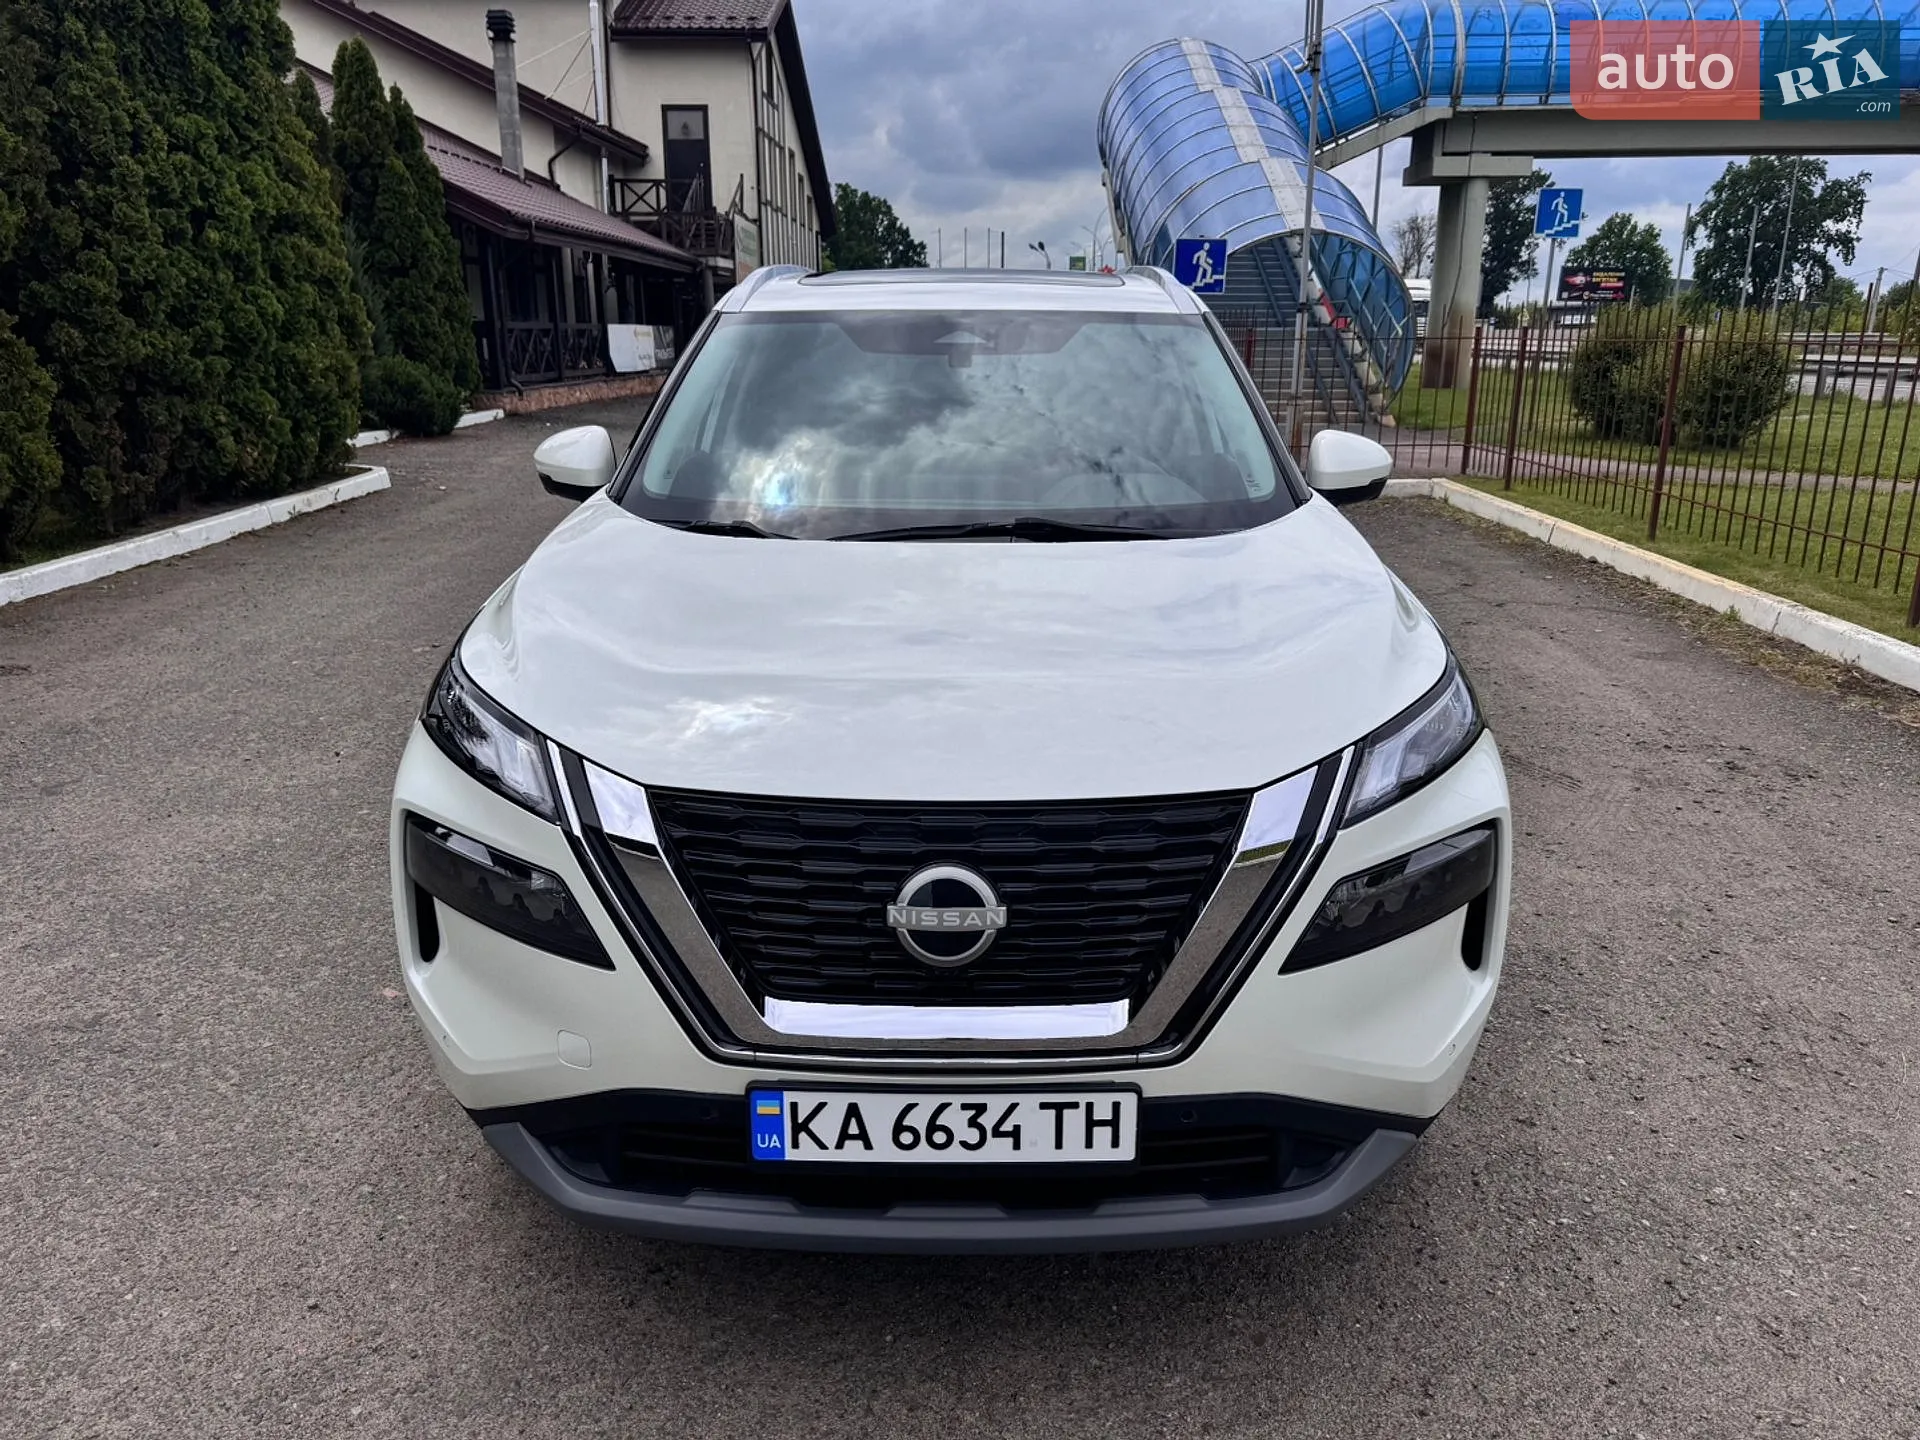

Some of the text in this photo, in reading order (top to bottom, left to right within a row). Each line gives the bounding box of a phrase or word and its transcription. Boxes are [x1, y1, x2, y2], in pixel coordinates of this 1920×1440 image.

[889, 908, 1004, 927] NISSAN
[789, 1100, 1122, 1151] KA 6634 TH
[756, 1133, 782, 1149] UA
